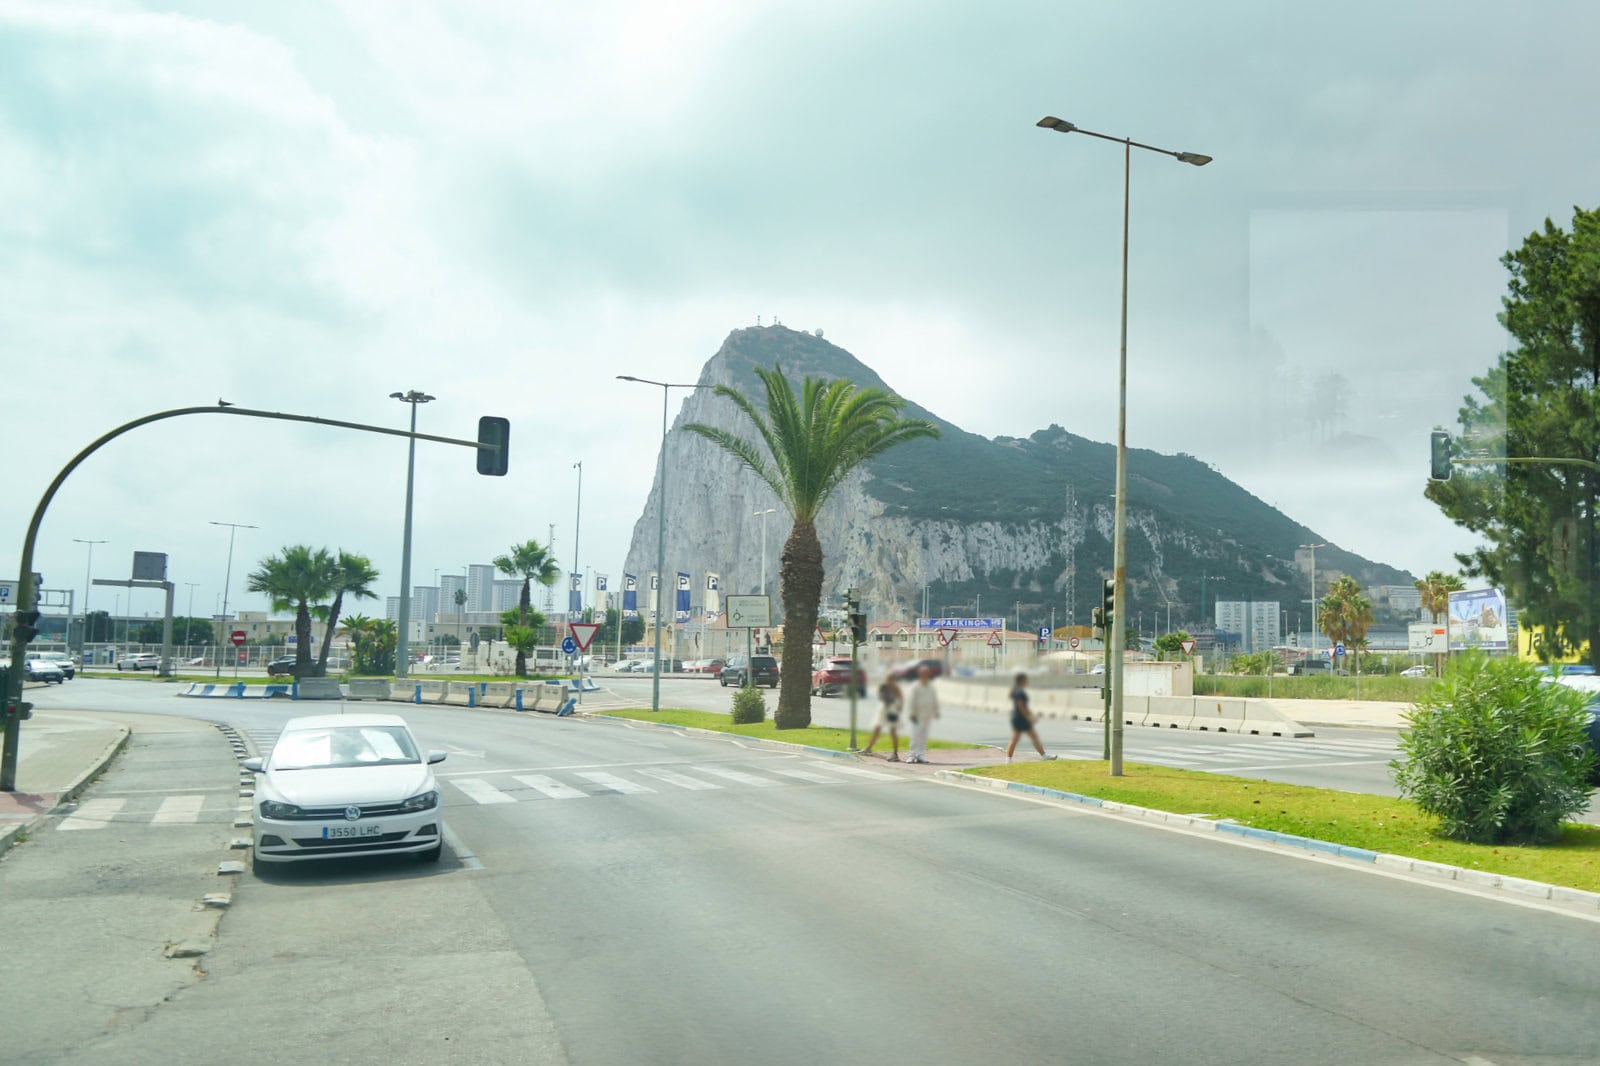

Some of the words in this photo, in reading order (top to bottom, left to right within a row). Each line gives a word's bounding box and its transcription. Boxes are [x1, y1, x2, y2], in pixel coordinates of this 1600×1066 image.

[942, 619, 981, 627] PARKING
[330, 827, 356, 838] 3550
[360, 825, 380, 836] LHC
